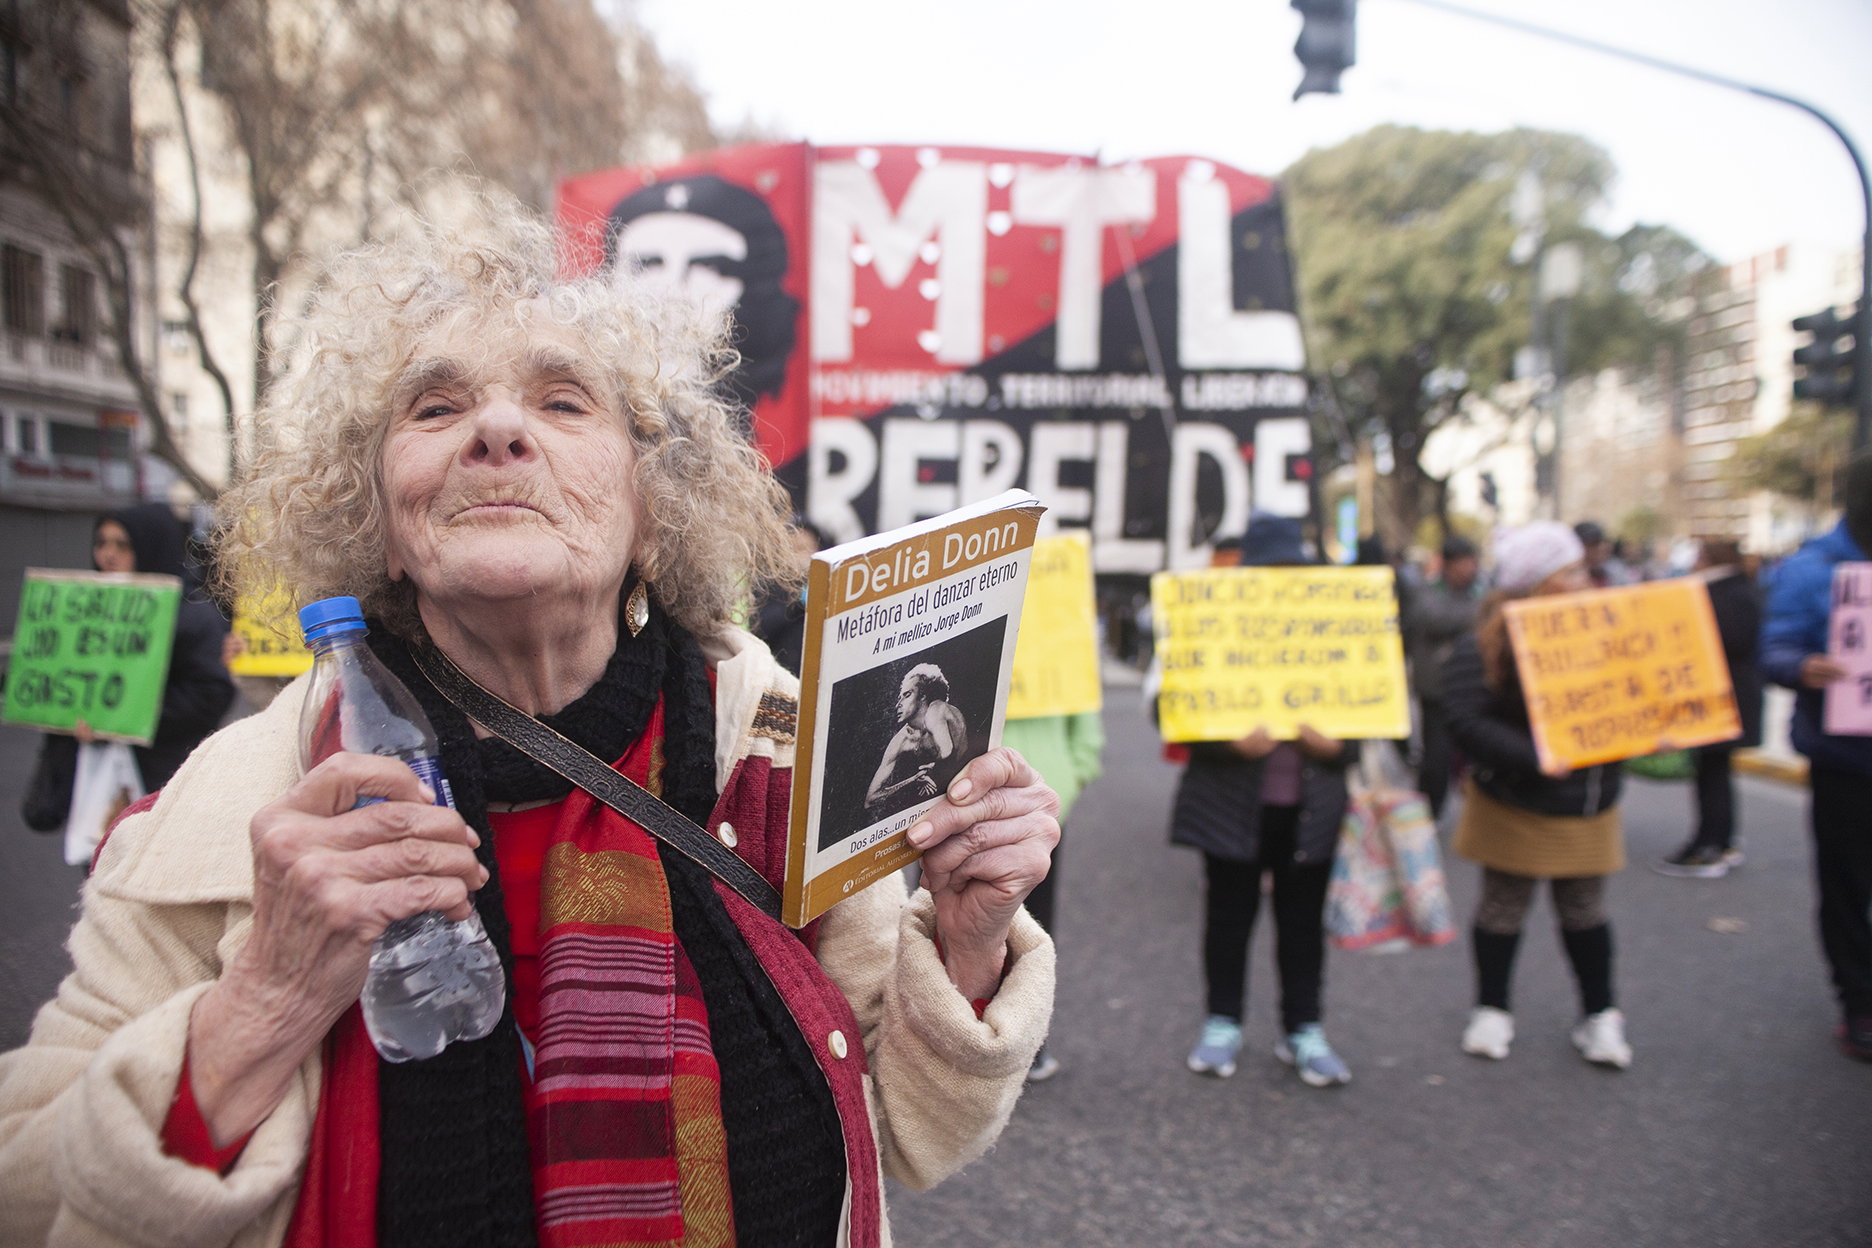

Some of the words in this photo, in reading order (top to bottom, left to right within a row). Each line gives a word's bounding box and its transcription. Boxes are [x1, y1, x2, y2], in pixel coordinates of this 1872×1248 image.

[808, 158, 1305, 369] MTL
[845, 546, 930, 603] Delia
[942, 521, 1019, 569] Donn
[837, 603, 902, 644] Metáfora
[907, 589, 929, 618] del
[933, 576, 976, 609] danzar
[979, 561, 1018, 591] eterno
[873, 638, 880, 654] A
[883, 631, 896, 651] mi
[897, 621, 932, 646] mellizo
[934, 612, 960, 633] Jorge
[961, 602, 983, 621] Donn
[14, 667, 125, 711] GASTO
[850, 838, 867, 854] Dos
[874, 843, 901, 860] Prosas
